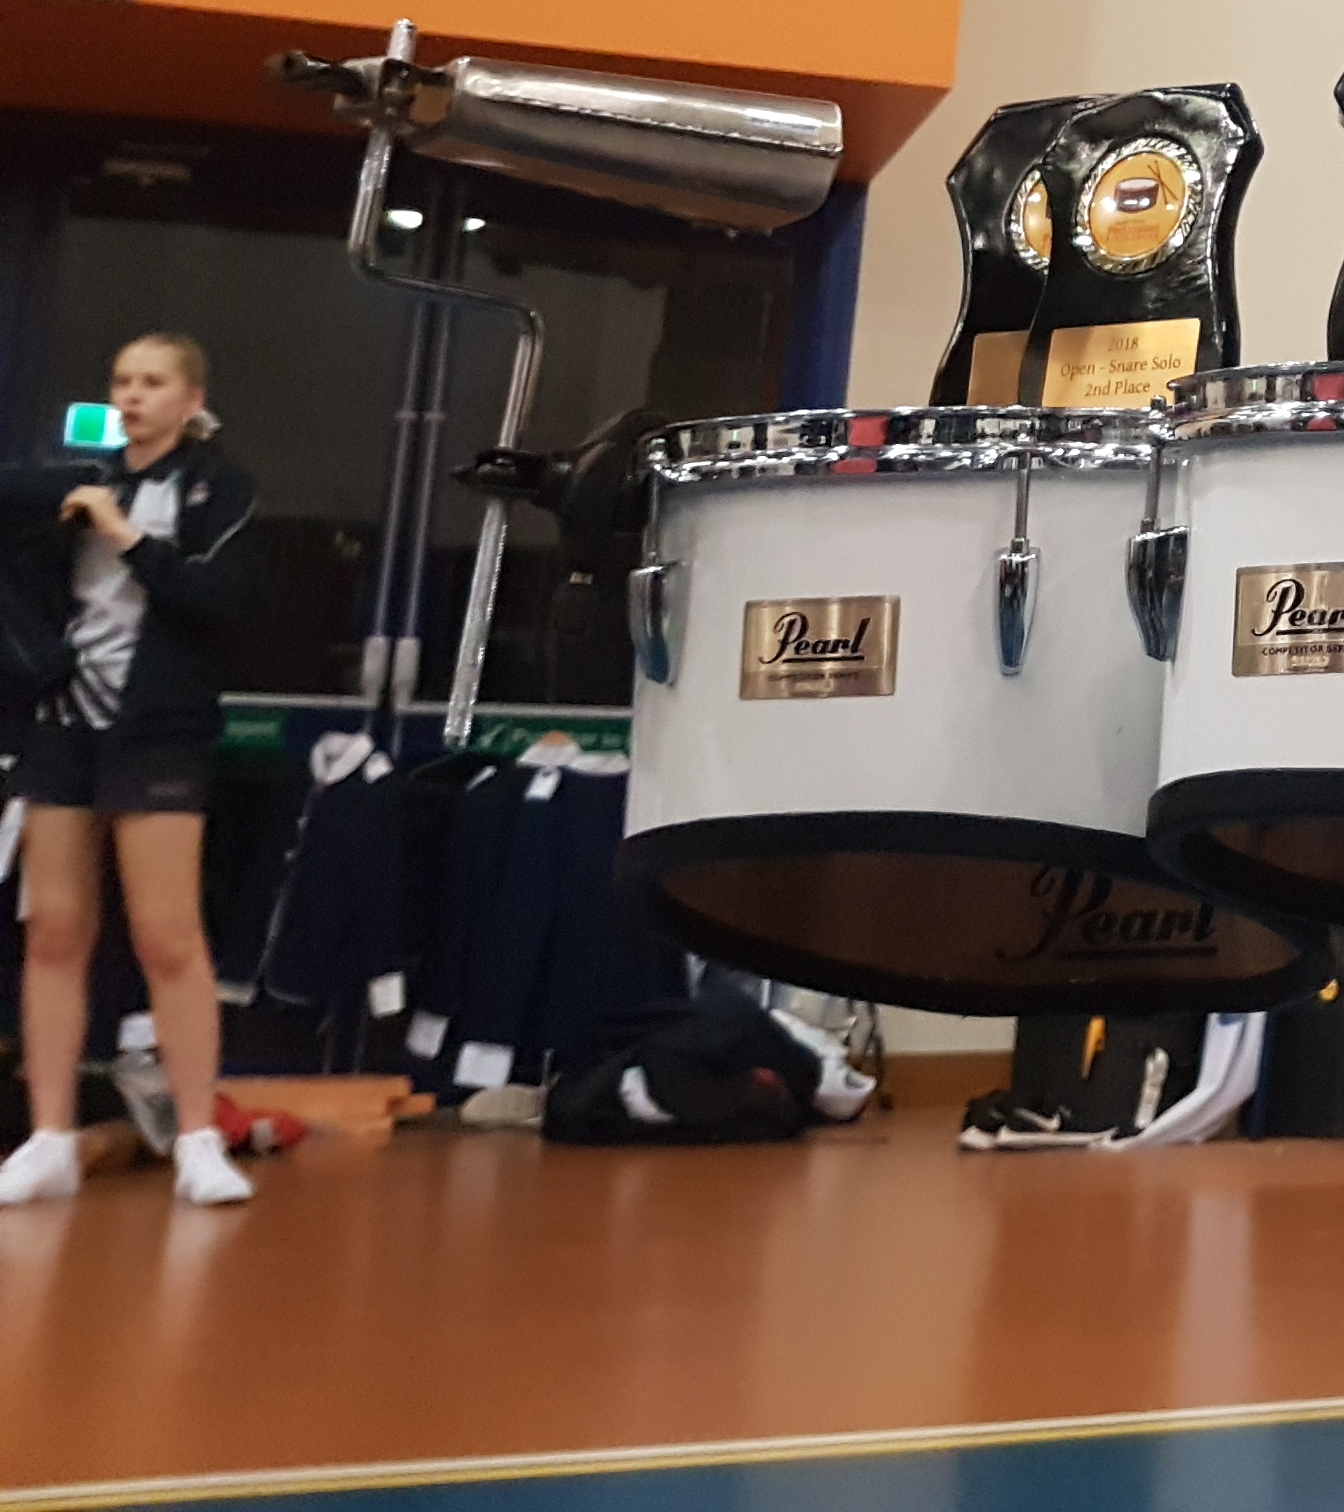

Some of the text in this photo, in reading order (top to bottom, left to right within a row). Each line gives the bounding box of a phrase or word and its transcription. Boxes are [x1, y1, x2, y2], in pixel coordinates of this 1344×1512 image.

[1108, 336, 1139, 352] 2018
[1060, 361, 1095, 380] Open
[1109, 358, 1148, 374] Snare
[1152, 354, 1181, 370] Solo
[1085, 379, 1151, 398] 2nd Place
[758, 612, 871, 664] Pearl
[994, 864, 1217, 962] Pearl
